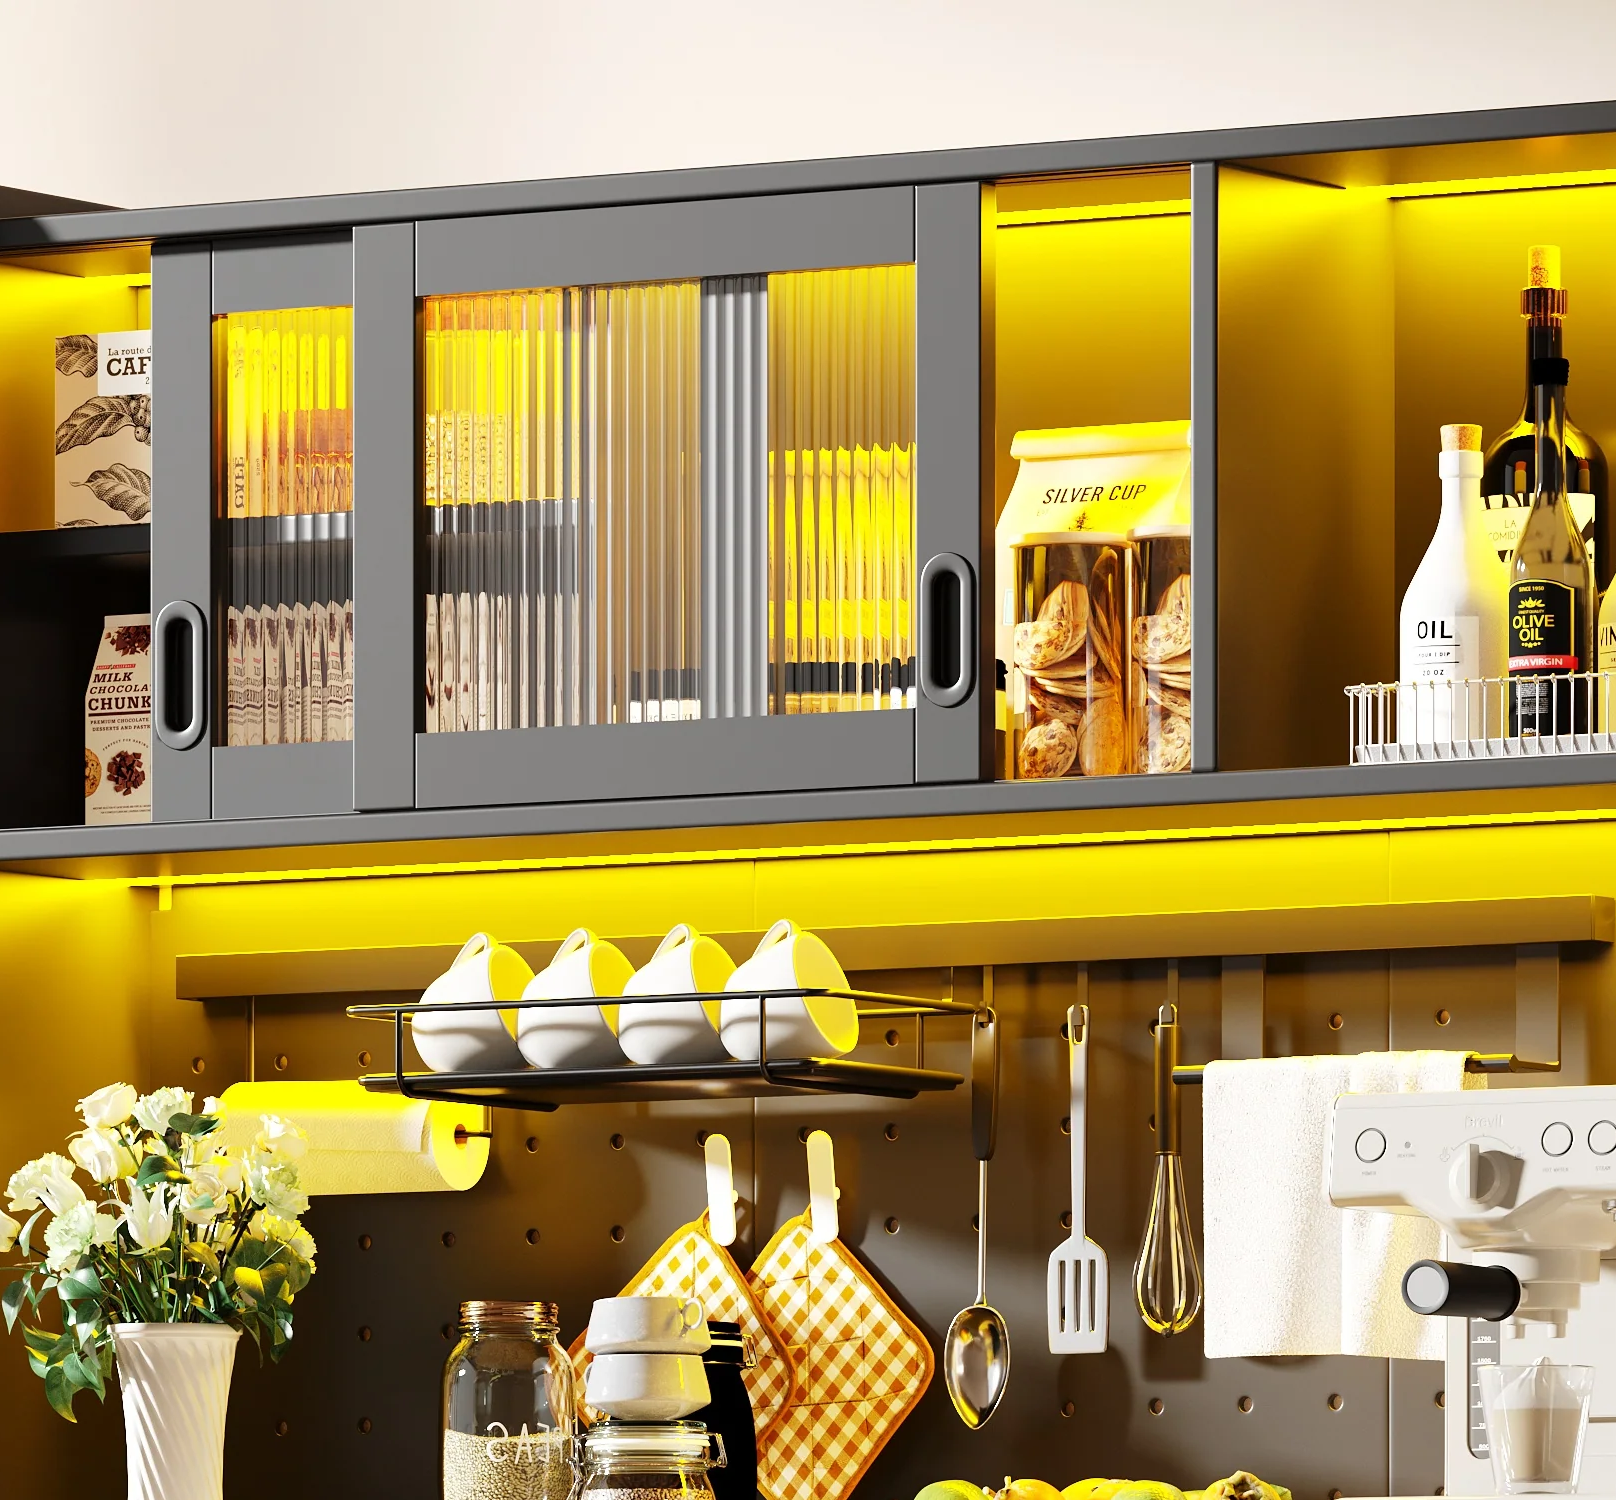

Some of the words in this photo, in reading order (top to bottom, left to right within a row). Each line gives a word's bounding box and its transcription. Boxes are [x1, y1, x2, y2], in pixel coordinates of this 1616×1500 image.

[108, 348, 119, 356] La
[121, 347, 144, 356] route
[1042, 486, 1104, 504] SILVER
[1108, 484, 1147, 501] CUP
[1504, 519, 1517, 529] LA
[1512, 614, 1555, 630] OLIVE
[1417, 620, 1453, 639] OIL
[1518, 627, 1545, 642] OIL
[1508, 658, 1530, 669] EXTRA
[1531, 657, 1563, 667] VIRGIN
[92, 672, 134, 683] MILK
[89, 683, 151, 695] CHOCOLA
[88, 695, 151, 711] CHUNK
